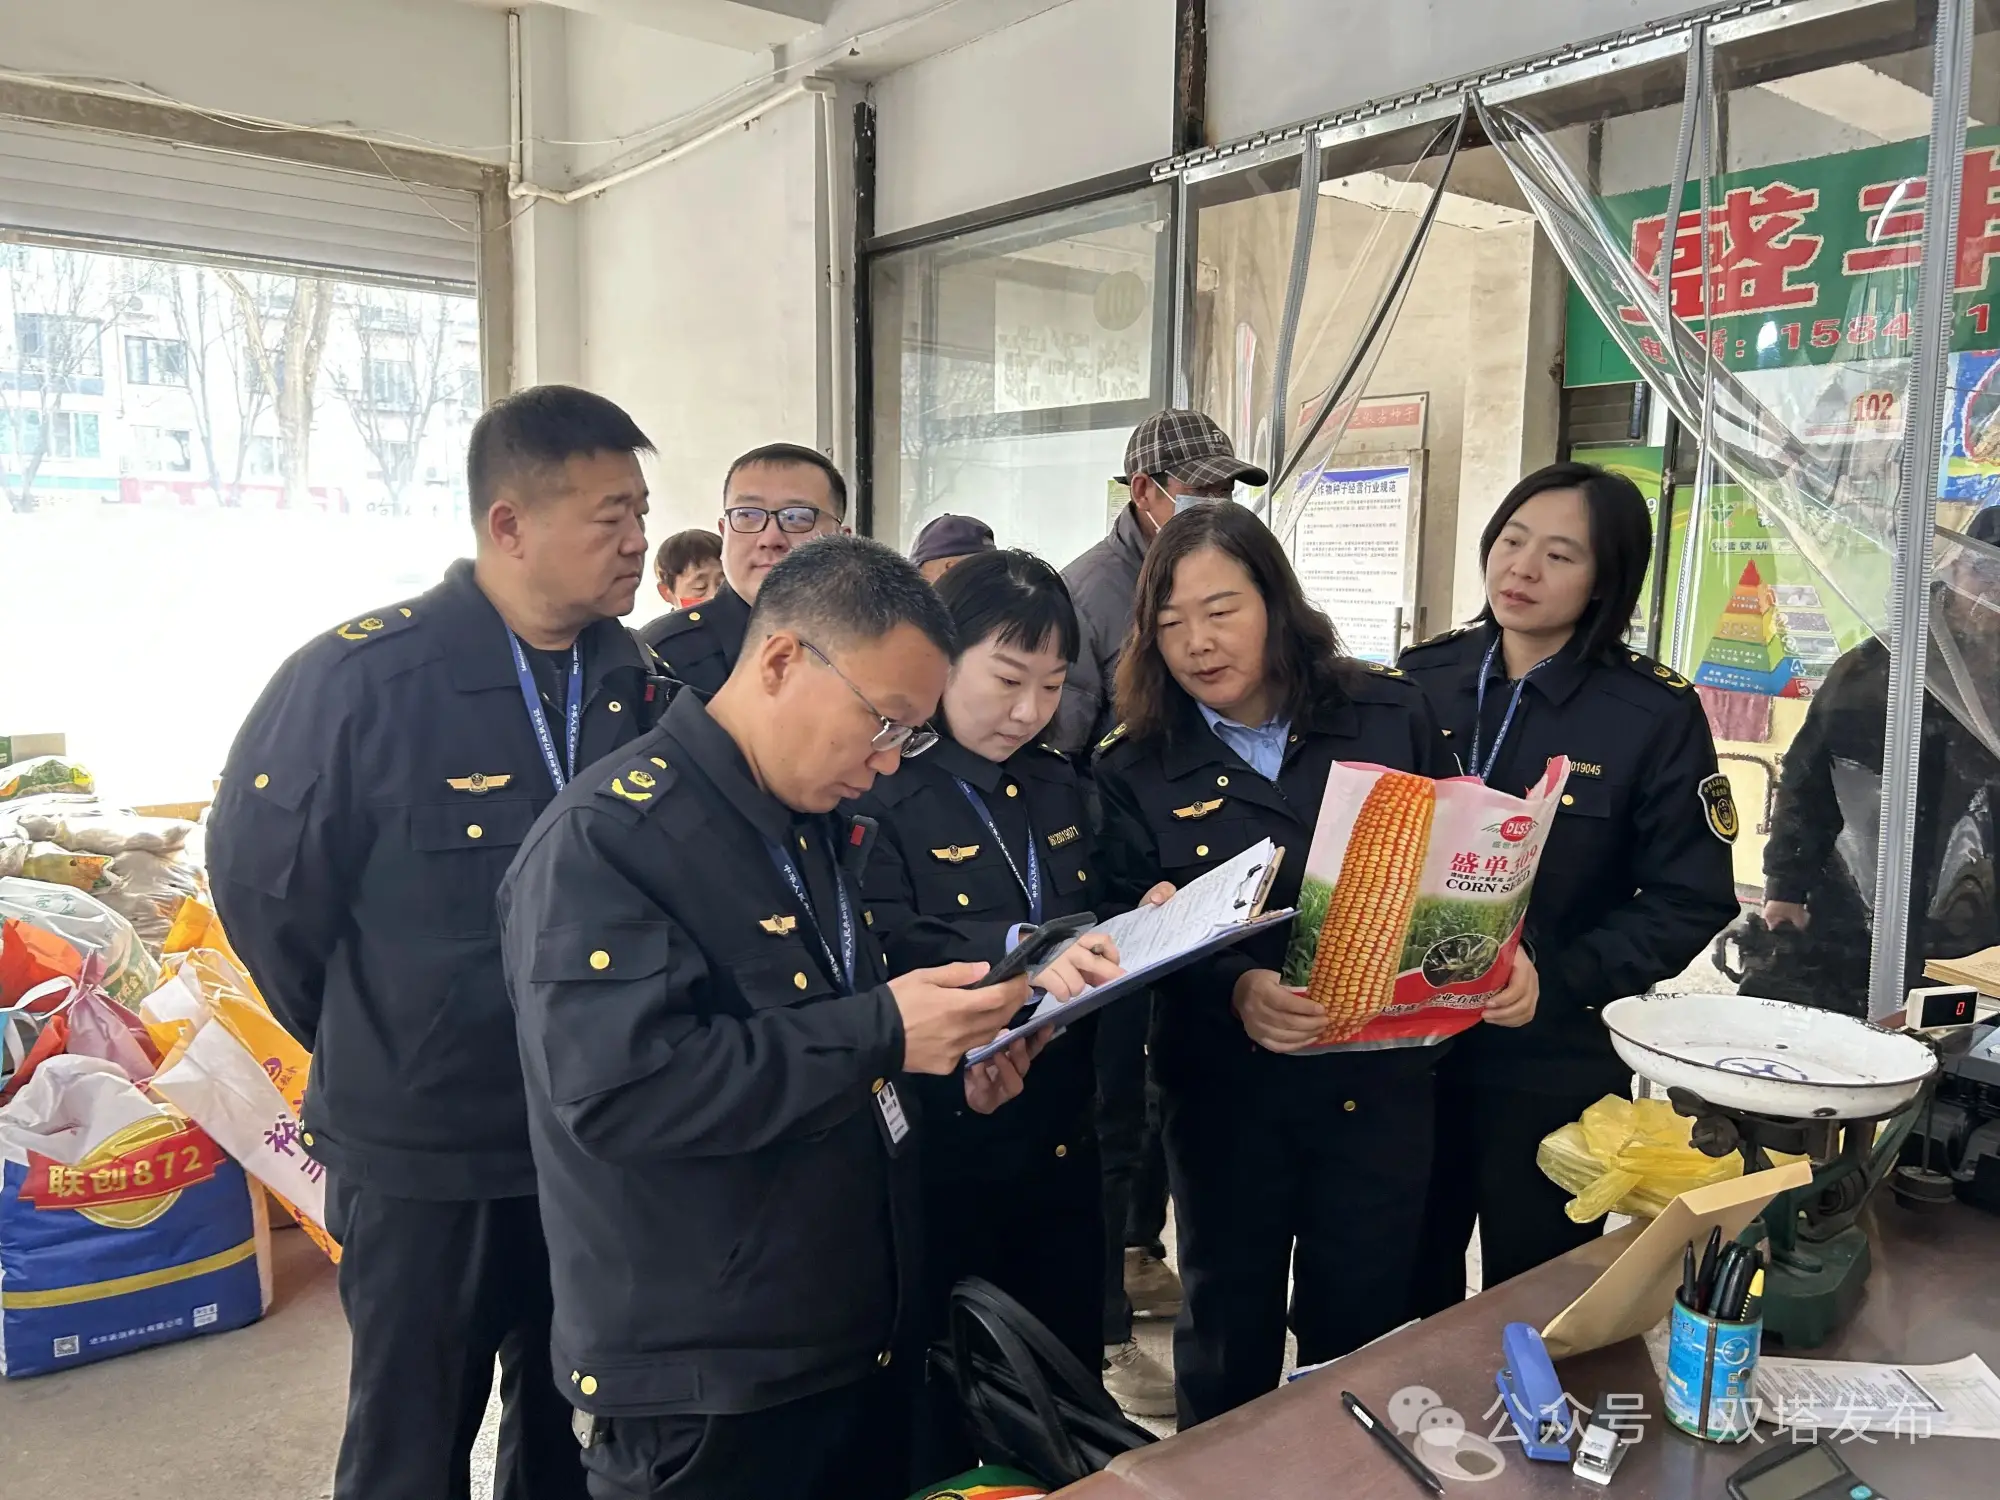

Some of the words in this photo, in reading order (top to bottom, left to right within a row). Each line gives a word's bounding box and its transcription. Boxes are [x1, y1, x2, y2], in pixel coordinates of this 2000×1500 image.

[1855, 393, 1894, 420] 102
[1505, 821, 1531, 835] DLSS
[1446, 878, 1499, 894] CORN
[1499, 870, 1531, 894] SEED
[1956, 1001, 1965, 1016] 0
[48, 1145, 204, 1198] 联创872
